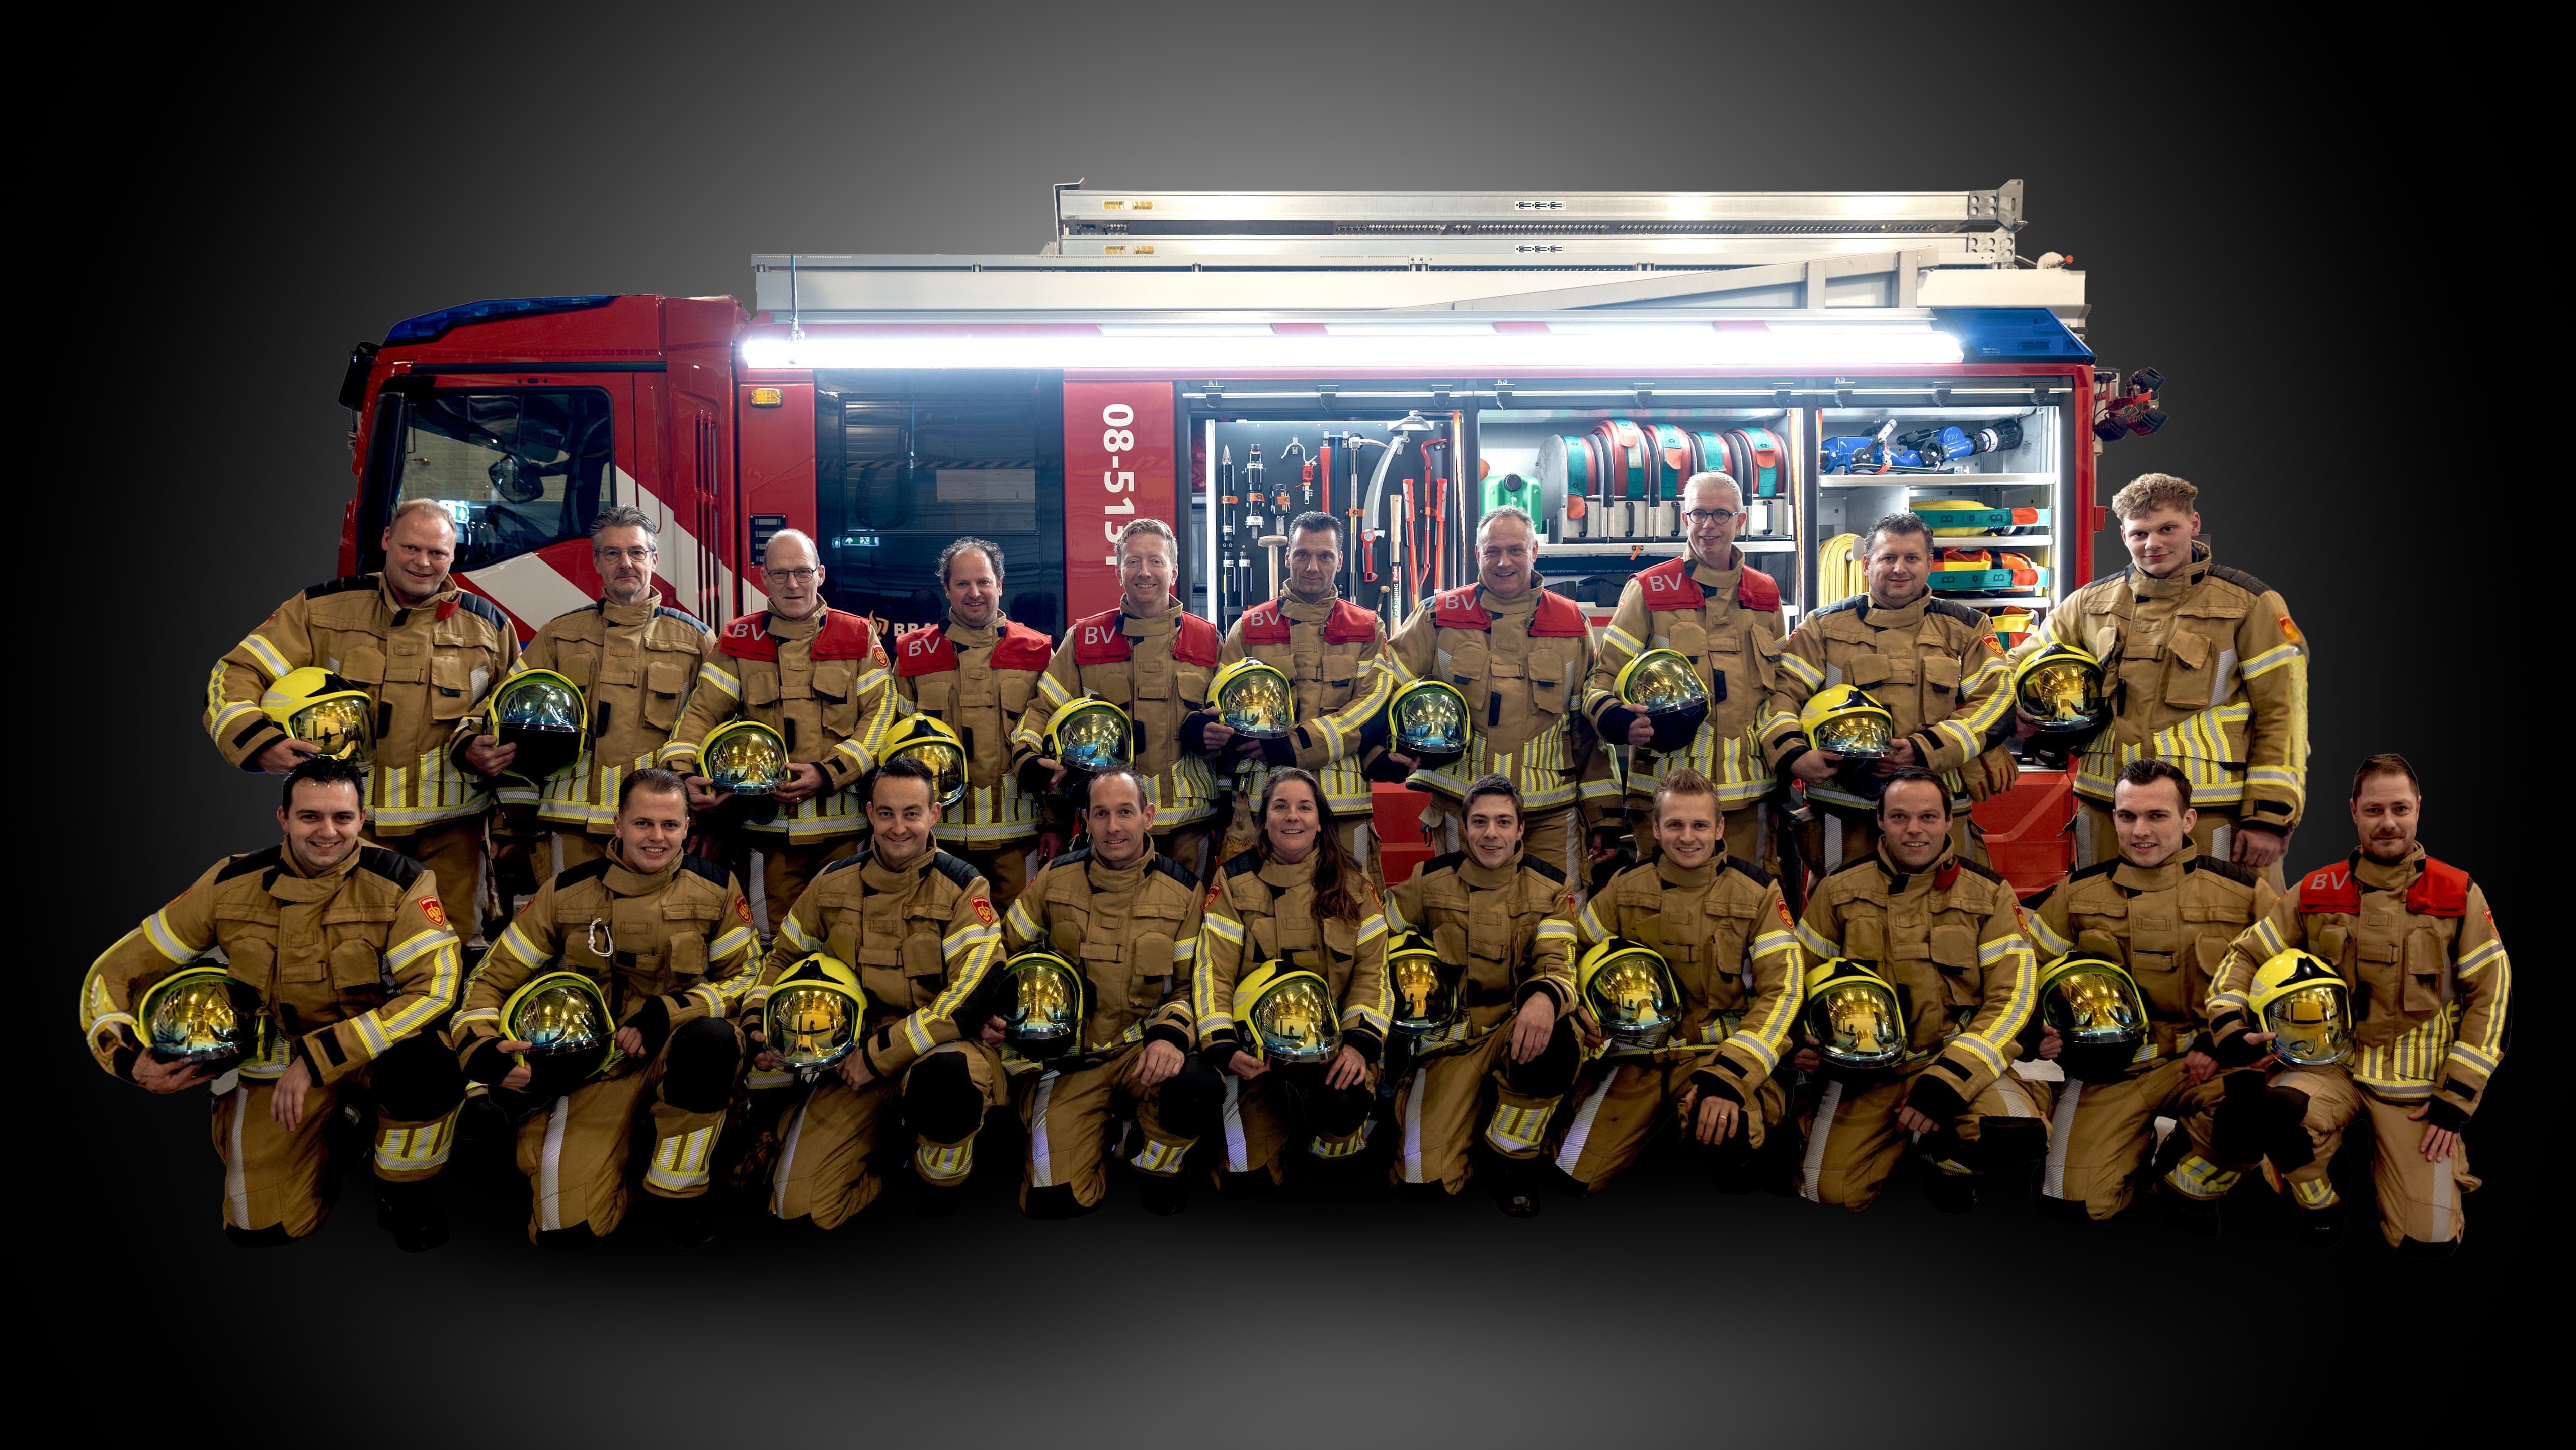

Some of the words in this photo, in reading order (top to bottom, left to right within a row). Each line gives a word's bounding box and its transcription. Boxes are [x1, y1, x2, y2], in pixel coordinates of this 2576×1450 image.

[1649, 573, 1682, 591] BV
[1445, 594, 1476, 610] BV
[1251, 611, 1281, 626] BV
[732, 623, 766, 641] BV
[1085, 626, 1116, 644] BV
[909, 637, 940, 656] BV
[2310, 871, 2350, 890] BV
